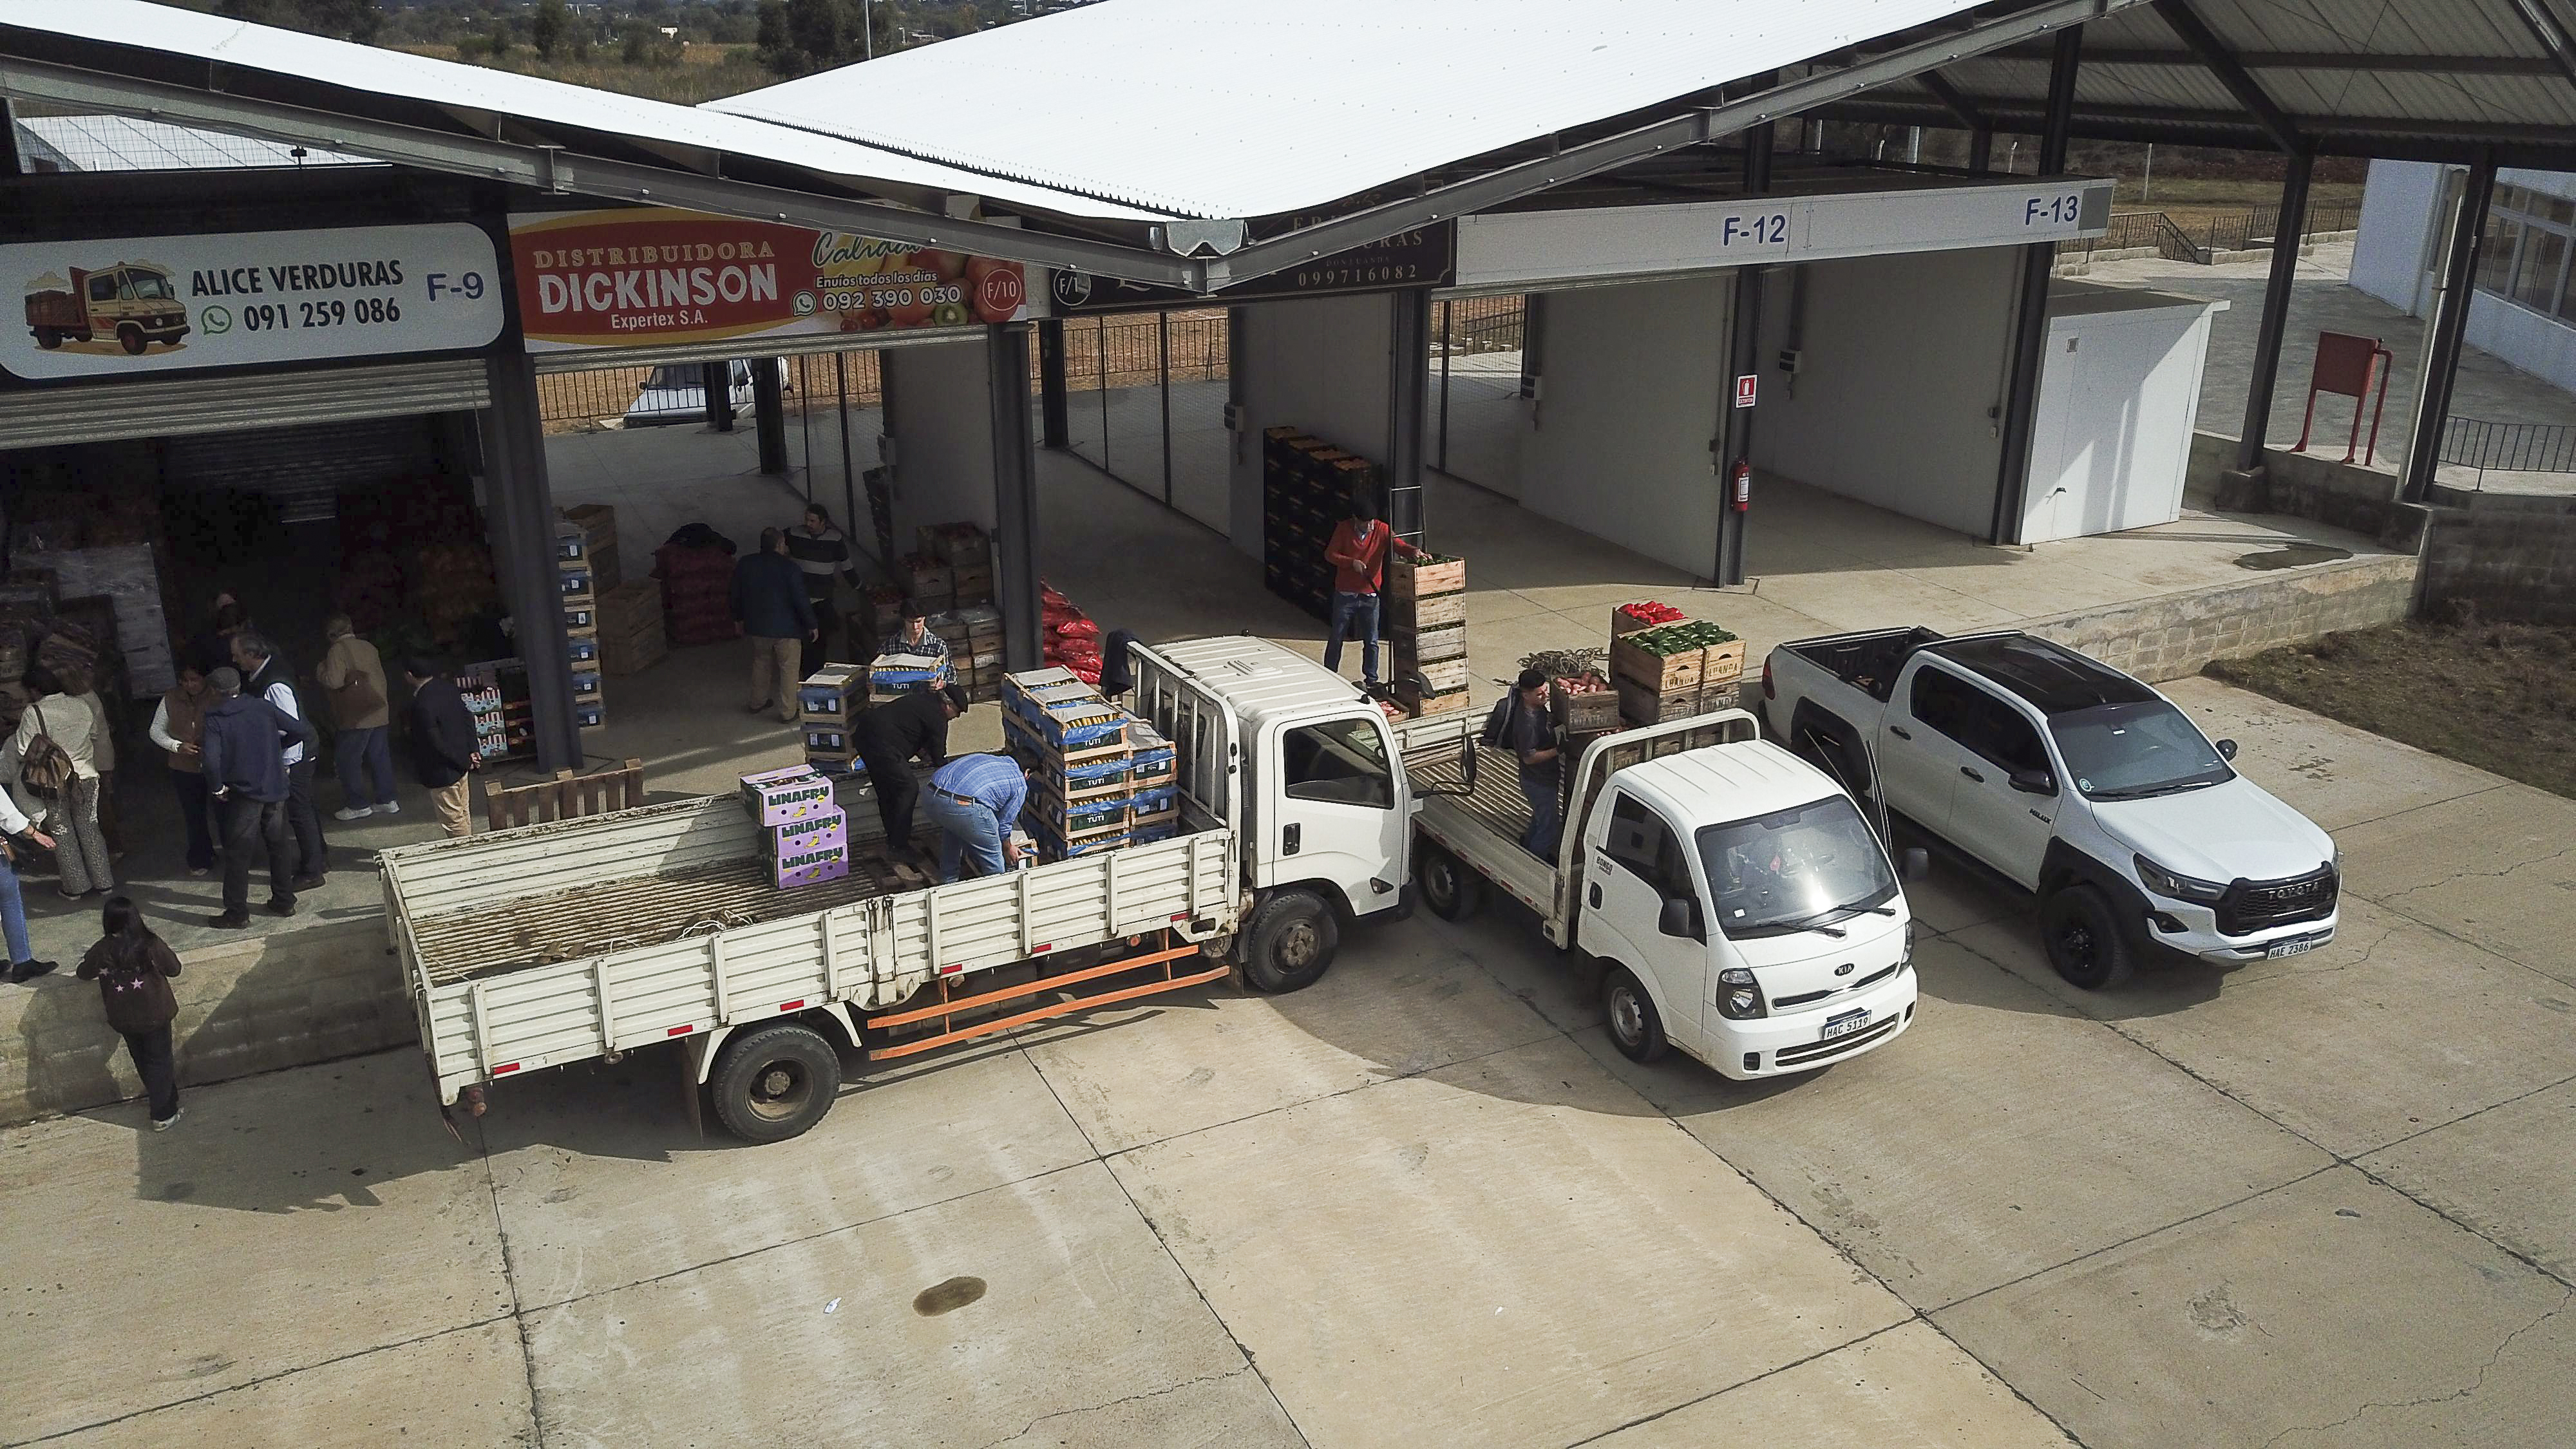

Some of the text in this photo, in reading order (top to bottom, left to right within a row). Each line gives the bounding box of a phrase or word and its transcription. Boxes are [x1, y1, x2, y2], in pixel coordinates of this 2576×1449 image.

[2025, 195, 2078, 226] F-13
[1723, 214, 1786, 246] F-12
[535, 241, 775, 269] DISTRIBUIDORA
[813, 232, 923, 267] Calida
[192, 260, 404, 296] ALICE VERDURAS
[426, 270, 485, 303] F-9
[538, 264, 779, 314] DICKINSON
[816, 269, 938, 289] Envíos todos los días
[822, 286, 962, 312] 092 390 030
[987, 281, 1017, 299] F/10
[243, 296, 402, 332] 091 259 086
[611, 310, 709, 332] Expertex S.A.
[1088, 777, 1104, 786] TUTI
[1087, 815, 1104, 824] TUTI
[1596, 856, 1613, 871] BONGO
[2268, 882, 2319, 900] TOYOTA
[2269, 947, 2286, 958] HAE
[2288, 942, 2309, 954] 2386
[1838, 964, 1852, 974] KIA
[1826, 1024, 1843, 1037] HAC
[1846, 1016, 1868, 1032] 5119
